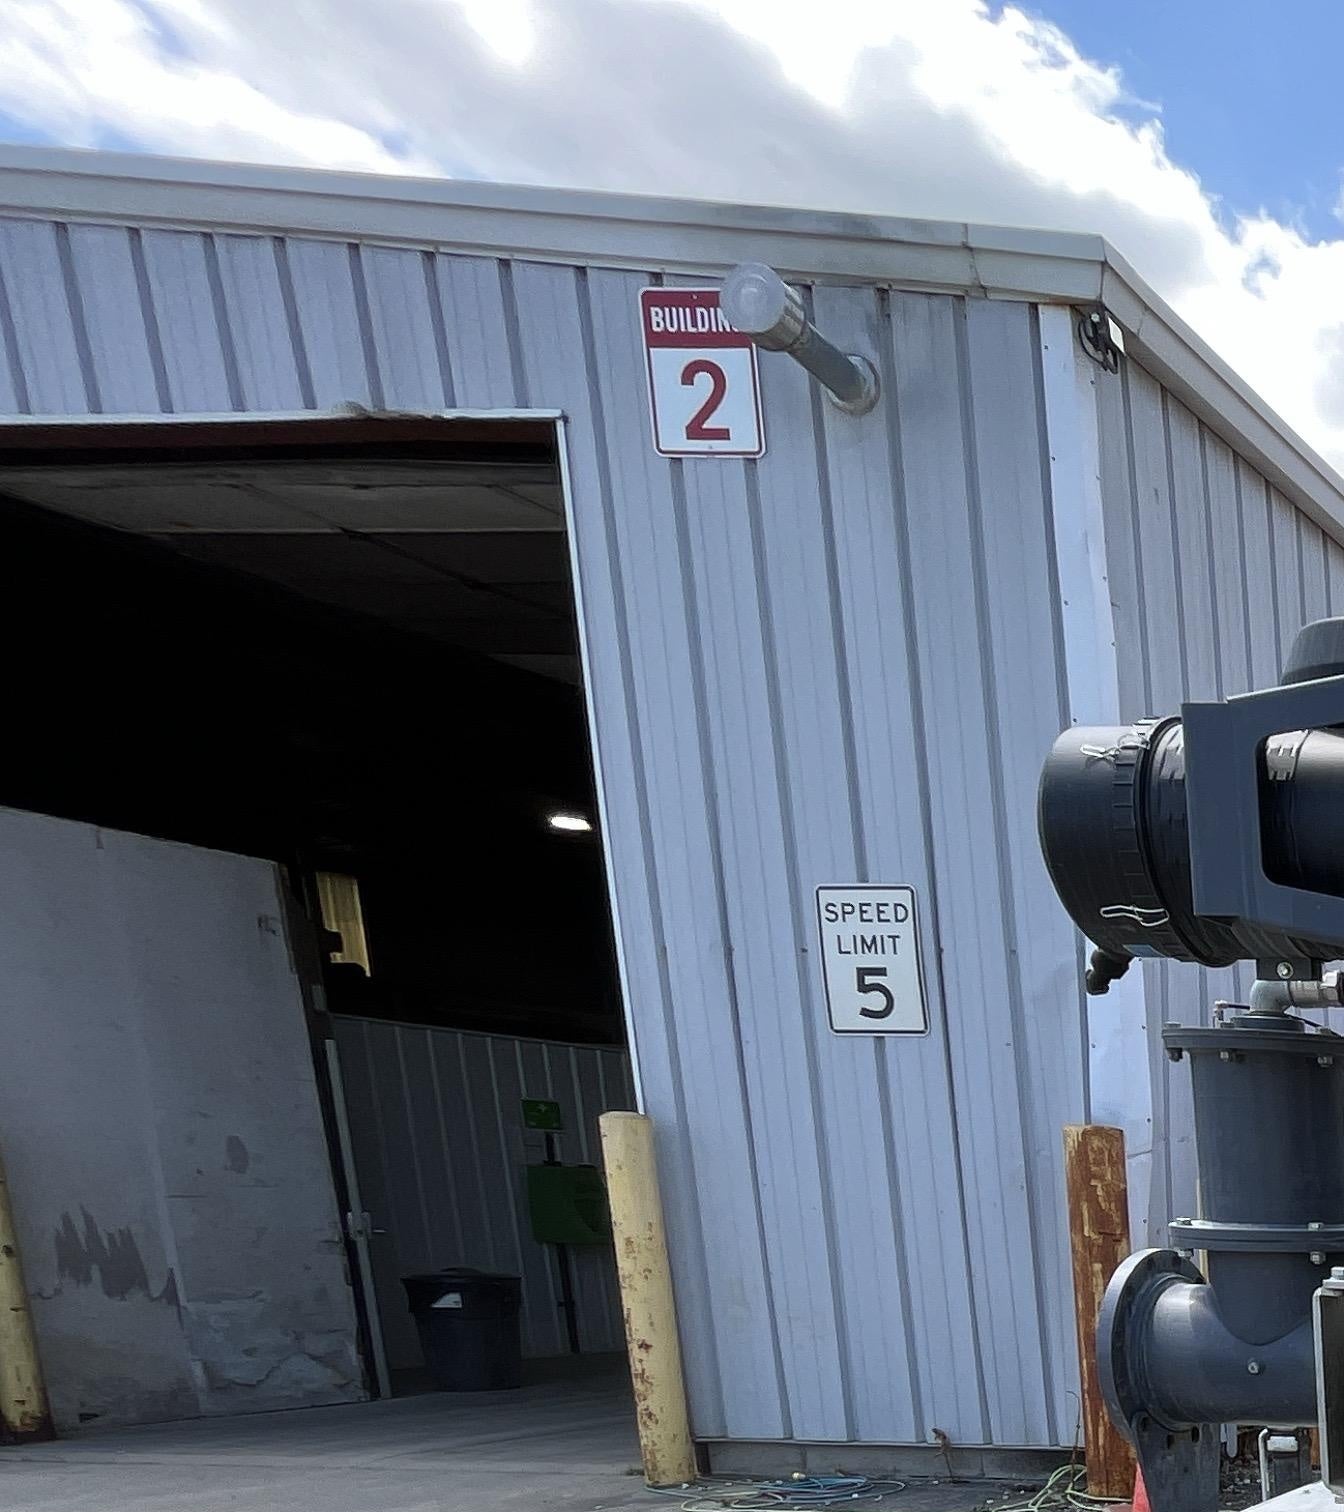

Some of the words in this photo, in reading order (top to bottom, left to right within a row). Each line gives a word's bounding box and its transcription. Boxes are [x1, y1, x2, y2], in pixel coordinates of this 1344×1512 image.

[650, 306, 739, 333] BUILDIN
[680, 359, 731, 441] 2
[824, 902, 909, 923] SPEED
[837, 934, 901, 955] LIMIT
[856, 967, 895, 1019] 5
